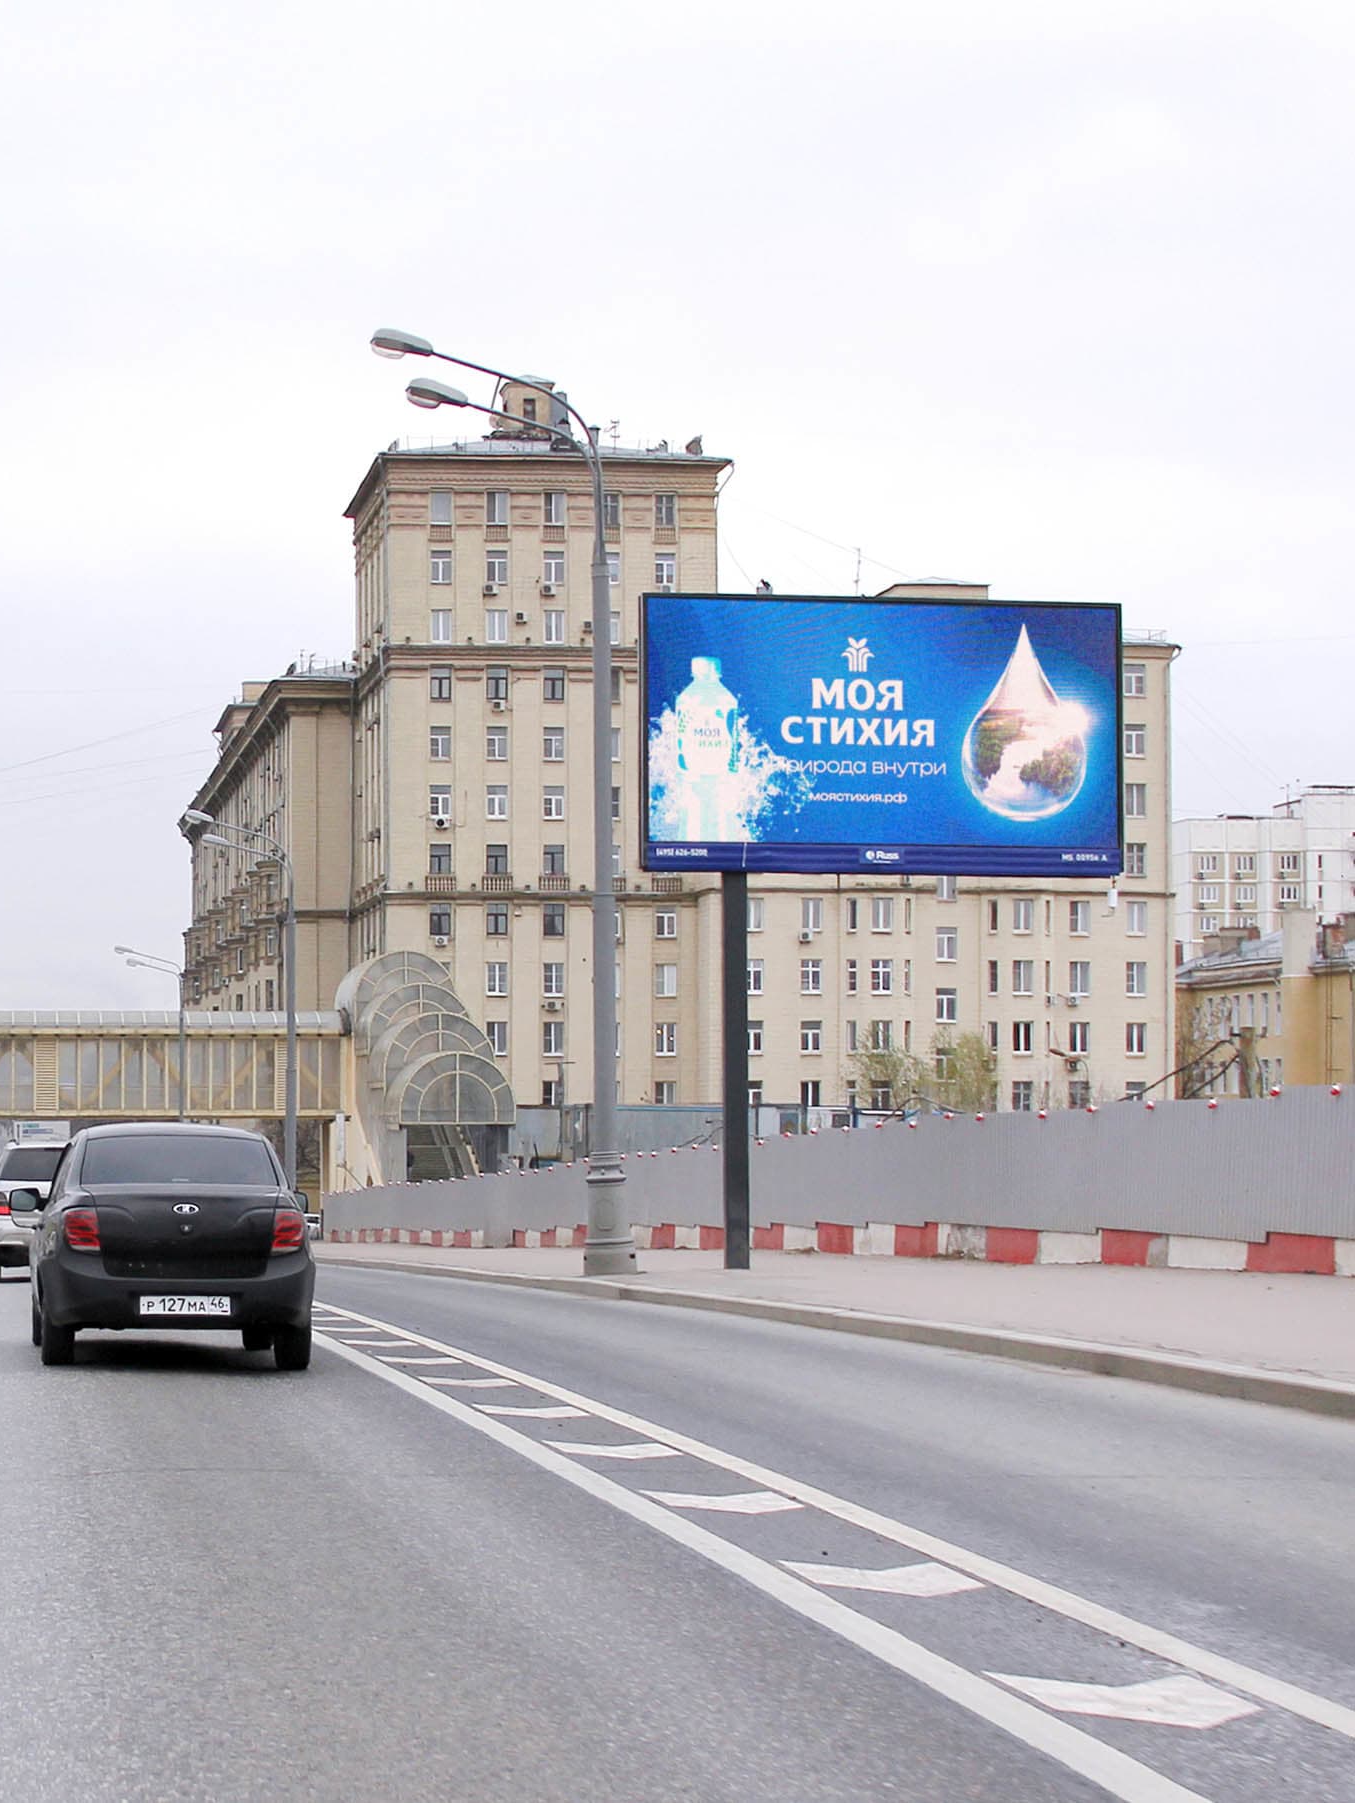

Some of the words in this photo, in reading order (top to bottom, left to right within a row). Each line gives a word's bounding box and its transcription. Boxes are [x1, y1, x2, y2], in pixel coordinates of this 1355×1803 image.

[811, 677, 904, 712] МОЯ
[780, 715, 936, 747] СТИХИЯ
[778, 759, 867, 776] рирода
[871, 761, 947, 778] внутри
[808, 791, 908, 803] моястихия.рф
